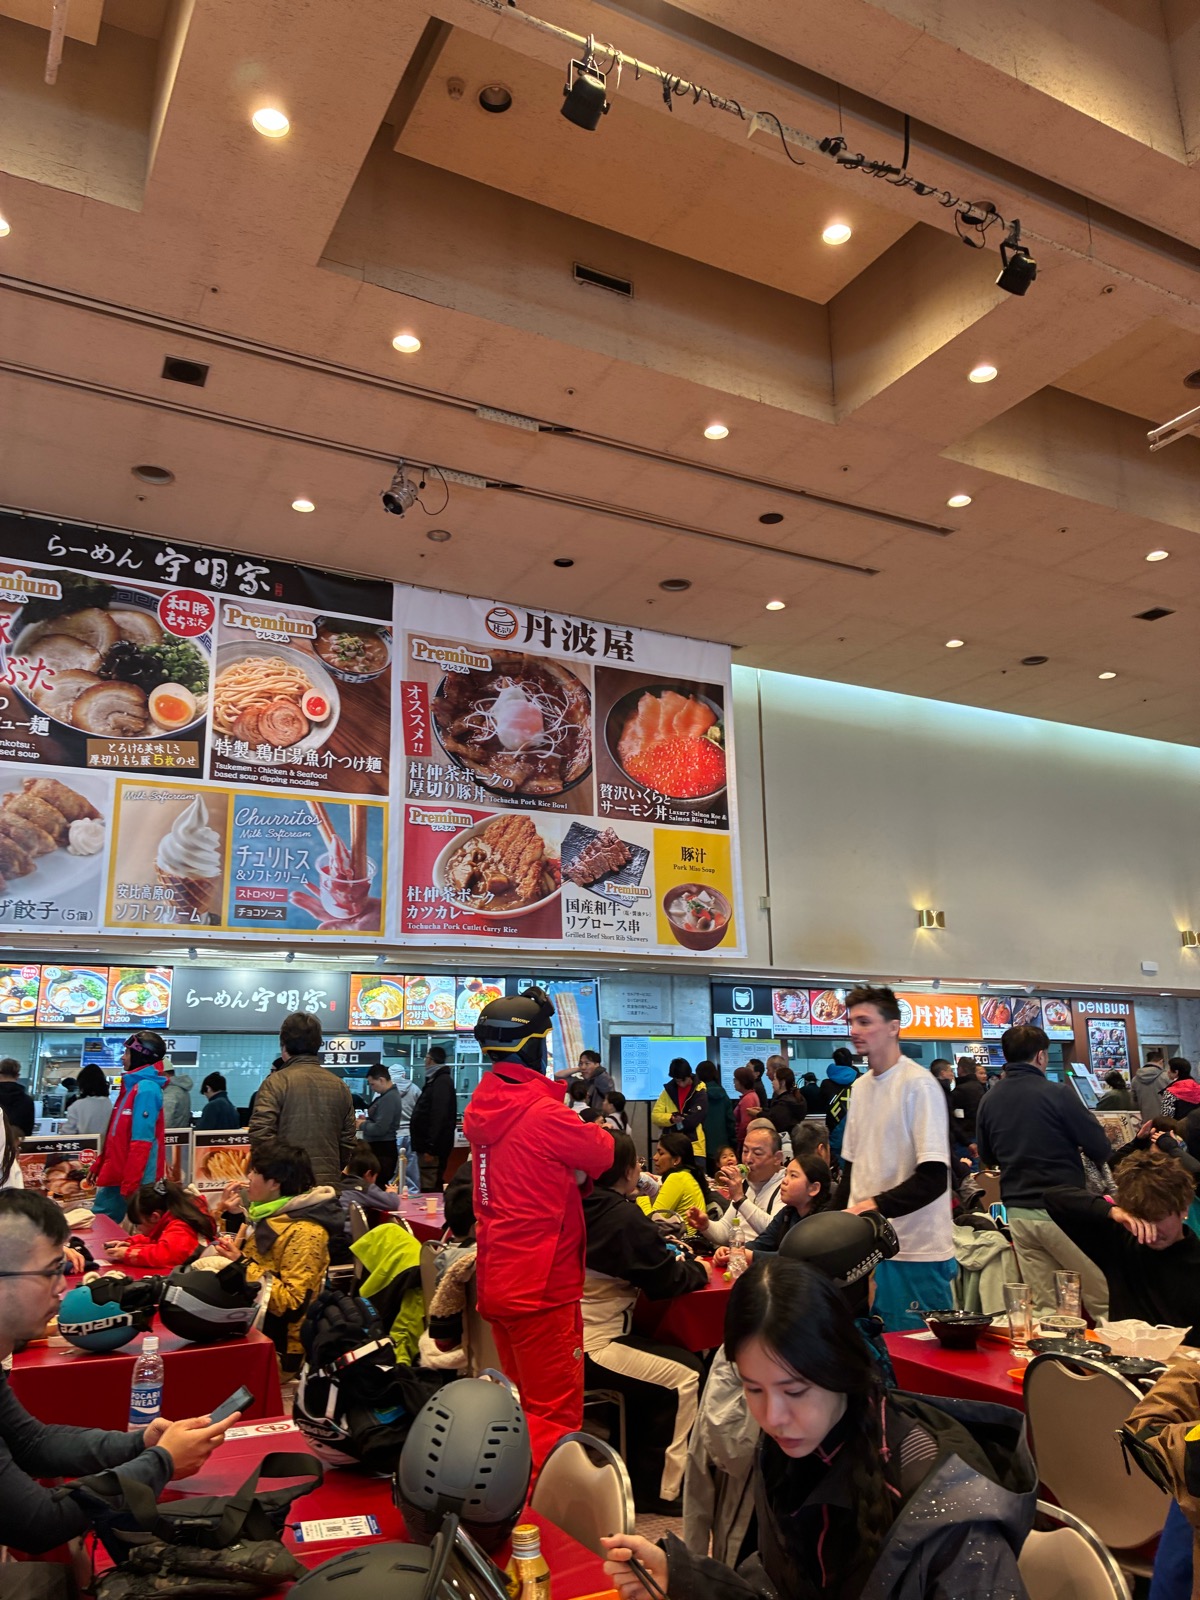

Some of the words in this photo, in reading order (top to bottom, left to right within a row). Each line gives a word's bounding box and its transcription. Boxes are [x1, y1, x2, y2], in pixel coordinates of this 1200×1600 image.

[47, 534, 144, 570] らーめん
[154, 546, 271, 596] 宇明家
[167, 594, 210, 617] 和豚
[165, 610, 207, 630] もちぶた
[227, 607, 314, 636] Premium
[257, 631, 289, 641] プレミアム
[521, 612, 636, 663] 丹波屋
[414, 641, 489, 669] Premium
[442, 663, 469, 673] プレミアム
[406, 684, 425, 753] オススメ!!
[18, 750, 40, 761] soup
[108, 743, 181, 755] とろける美味しさ
[214, 738, 250, 759] 特製
[255, 743, 383, 775] 鶏白湯魚介つけ麺
[89, 754, 197, 767] 厚切りもち豚5枚のせ
[214, 761, 253, 772] Tsukemen
[258, 766, 288, 776] Chicken
[289, 769, 295, 777] &
[296, 769, 328, 780] Seafood
[408, 761, 514, 789] 杜仲茶ポークの
[214, 770, 238, 780] based
[239, 774, 258, 783] soup
[259, 775, 288, 786] dipping
[289, 778, 320, 788] noodles
[124, 790, 146, 801] Milk
[149, 790, 195, 804] Softcream
[408, 778, 487, 805] 厚切り豚丼
[599, 784, 672, 806] 贅沢いくらと
[520, 798, 537, 807] Pork
[537, 800, 551, 808] Rice
[600, 800, 668, 821] サーモン丼
[235, 807, 322, 827] Churritos
[411, 809, 472, 826] Premium
[668, 815, 690, 823] Salmon
[691, 817, 703, 825] Rice
[703, 818, 717, 826] Bowl
[691, 810, 710, 819] Salmon
[240, 829, 263, 840] Milk
[265, 829, 312, 842] Softcream
[236, 845, 311, 871] チュリトス
[680, 846, 708, 864] 豚汁
[236, 869, 310, 884] &ソフトクリーム
[673, 864, 688, 872] Pork
[702, 866, 716, 875] Soup
[116, 884, 176, 901] 安比高原の
[238, 890, 285, 900] ストロベリー
[406, 886, 496, 906] 杜仲茶ポーク
[605, 882, 650, 897] Premium
[116, 904, 202, 924] ソフトクリーム
[238, 907, 284, 918] チョコソース
[406, 905, 476, 920] カツカレー
[565, 898, 622, 917] 国産和牛
[407, 922, 442, 931] Tochucha
[443, 923, 460, 931] Pork
[462, 924, 482, 932] Cutlet
[483, 925, 502, 934] Curry
[503, 926, 518, 935] Rice
[565, 916, 641, 935] リブロース串
[565, 931, 586, 940] Grilled
[587, 932, 600, 940] Beef
[615, 933, 626, 942] Rib
[186, 988, 250, 1008] らーめん
[725, 1016, 763, 1028] RETURN
[913, 1004, 975, 1029] 丹波屋
[731, 1028, 758, 1038] 返却口
[350, 1040, 366, 1051] UP
[964, 1045, 989, 1054] ORDER
[324, 1053, 359, 1064] 受取口
[975, 1055, 988, 1064] 文口
[846, 1251, 885, 1283] MASTER
[130, 1390, 161, 1402] POCARI
[130, 1398, 159, 1408] SWEAT
